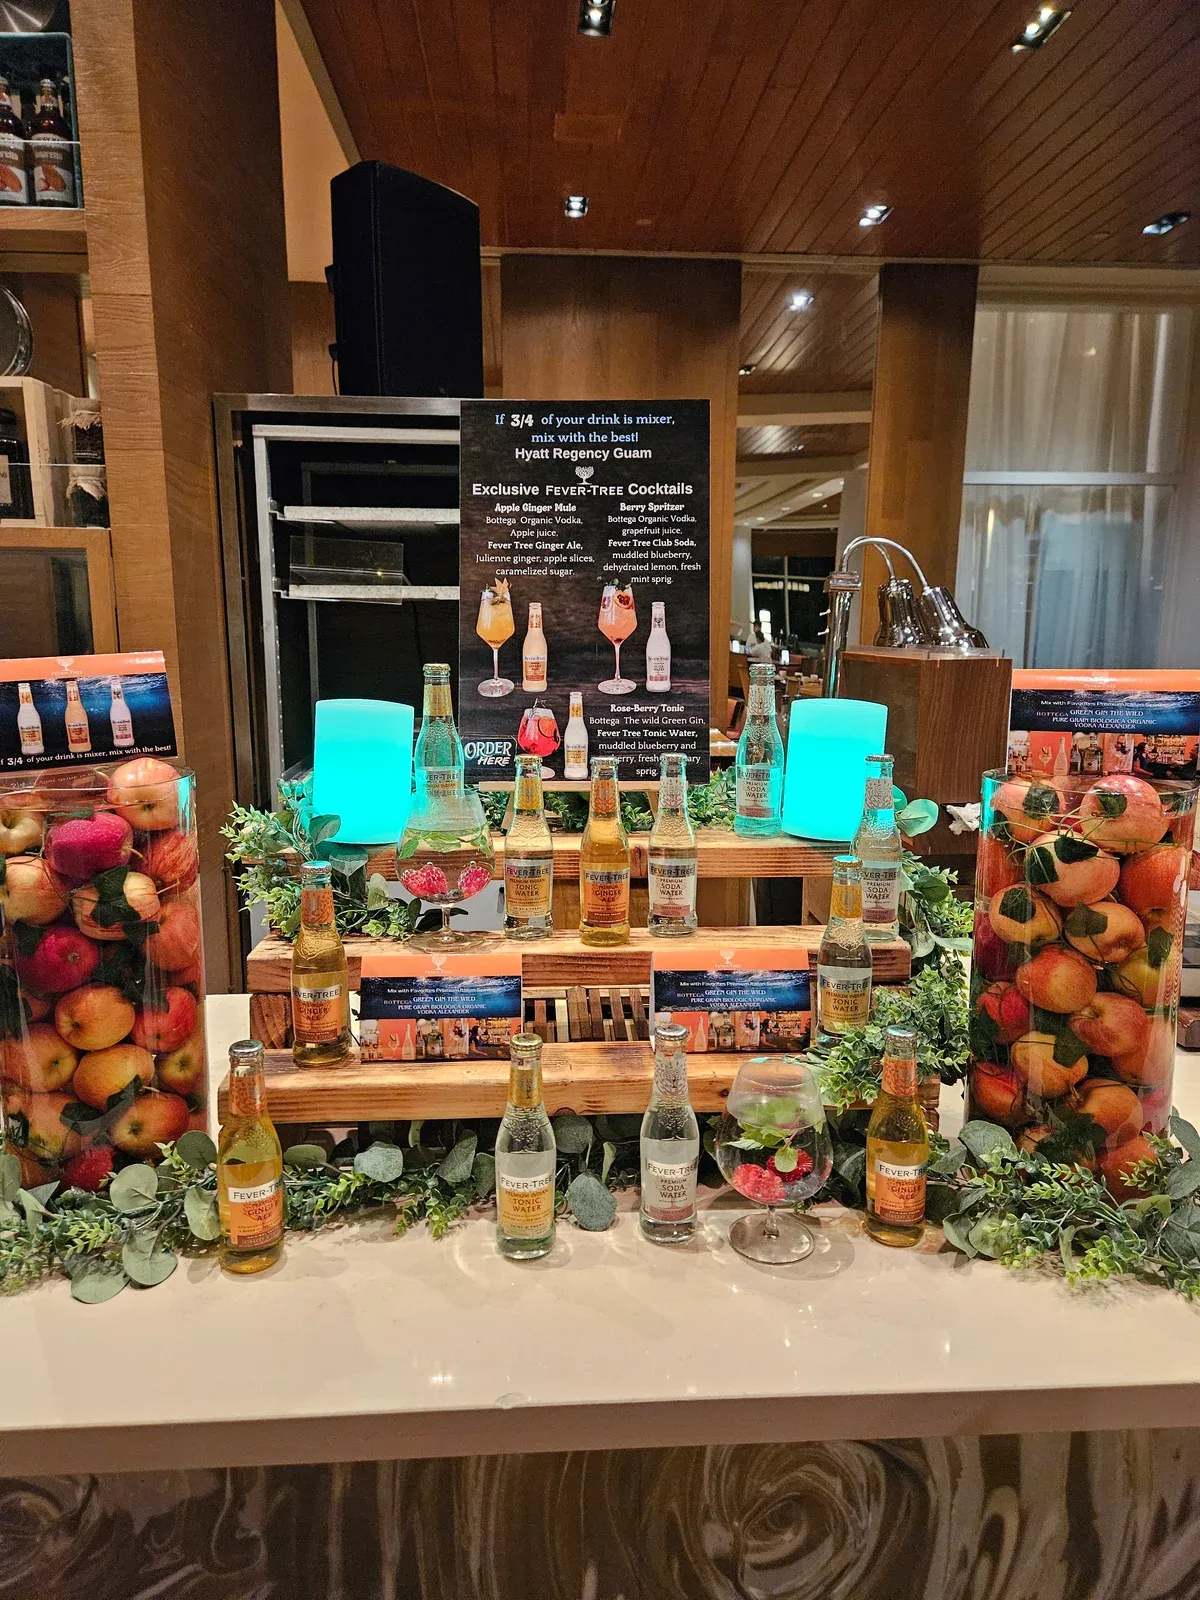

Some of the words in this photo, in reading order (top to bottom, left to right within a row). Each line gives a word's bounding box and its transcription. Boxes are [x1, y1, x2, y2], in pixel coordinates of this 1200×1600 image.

[495, 415, 504, 424] If
[510, 414, 533, 428] 3/4
[541, 414, 554, 424] of
[556, 416, 585, 427] your
[587, 414, 620, 424] drink
[624, 415, 632, 424] is
[636, 415, 675, 426] mixer,
[531, 433, 555, 442] mix
[558, 433, 585, 442] with
[588, 433, 607, 442] the
[610, 433, 638, 442] best!
[515, 448, 549, 461] Hyatt
[553, 448, 609, 461] Regency
[613, 448, 651, 459] Guam
[472, 483, 539, 495] Exclusive
[545, 485, 623, 495] FEVER-TREE
[628, 483, 693, 495] Cocktails
[495, 503, 520, 513] Apple
[522, 503, 552, 513] Ginger
[555, 503, 576, 511] Mule
[620, 503, 646, 512] Berry
[648, 503, 685, 512] Spritzer
[486, 516, 516, 525] Bottega
[520, 516, 552, 525] Organic
[608, 515, 636, 524] Bottega
[638, 515, 668, 524] Organic
[510, 529, 534, 538] Apple
[622, 527, 660, 536] grapefruit
[488, 541, 512, 549] Fever
[514, 541, 533, 549] Tree
[536, 541, 564, 551] Ginger
[566, 541, 583, 550] Ale,
[674, 538, 696, 547] Soda,
[476, 554, 511, 563] Julienne
[513, 554, 542, 564] ginger,
[544, 554, 568, 564] apple
[570, 554, 595, 563] slices,
[613, 551, 649, 559] muddled
[496, 567, 548, 575] caramelized
[549, 568, 574, 577] sugar.
[603, 563, 649, 572] dehydrated
[652, 576, 673, 584] sprig.
[610, 704, 659, 713] Rose-Berry
[661, 704, 684, 712] Tonic
[590, 717, 620, 726] Bottega
[642, 716, 659, 724] wild
[643, 729, 667, 737] Tonic
[669, 729, 698, 738] Water,
[464, 741, 511, 759] ORDER
[598, 742, 636, 750] muddled
[638, 742, 679, 751] blueberry
[7, 757, 23, 766] 3/4
[477, 757, 510, 767] HERE
[638, 754, 659, 762] fresh
[636, 767, 658, 777] sprig.
[586, 873, 628, 881] FEVER-TREE
[501, 1175, 552, 1189] FEVER-TREE
[514, 1197, 540, 1205] TONIC
[258, 1213, 271, 1221] ALE
